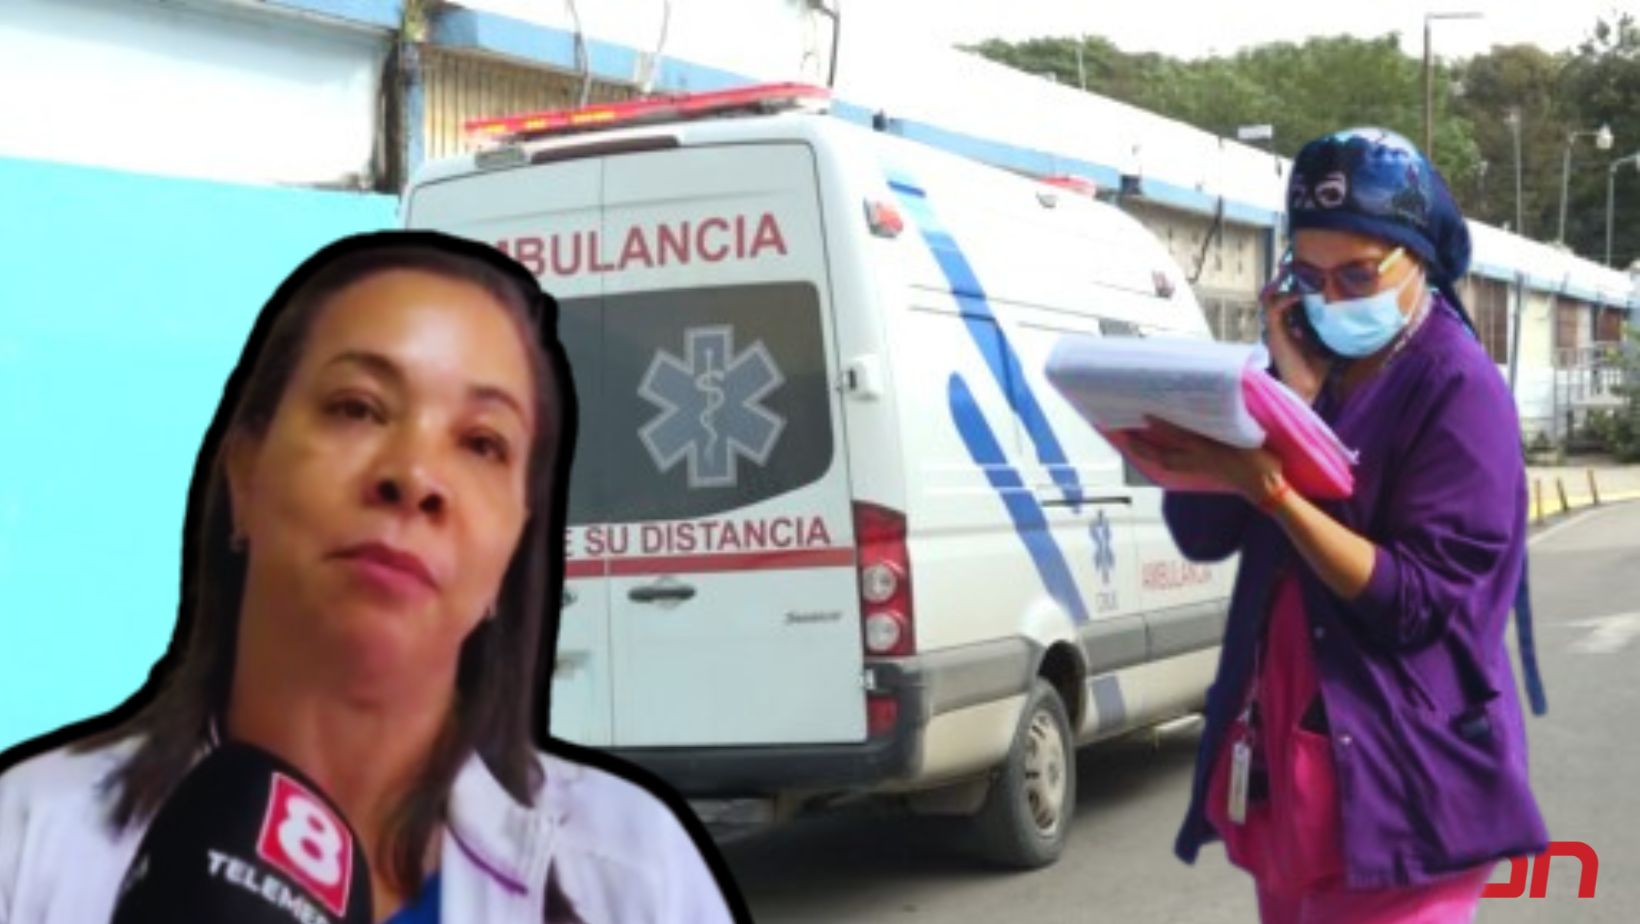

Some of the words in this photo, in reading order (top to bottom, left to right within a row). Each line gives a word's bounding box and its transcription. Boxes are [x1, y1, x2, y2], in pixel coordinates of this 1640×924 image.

[497, 212, 787, 278] BULANCIA
[584, 525, 629, 555] SU
[641, 516, 831, 554] DISTANCIA
[278, 795, 344, 886] 8
